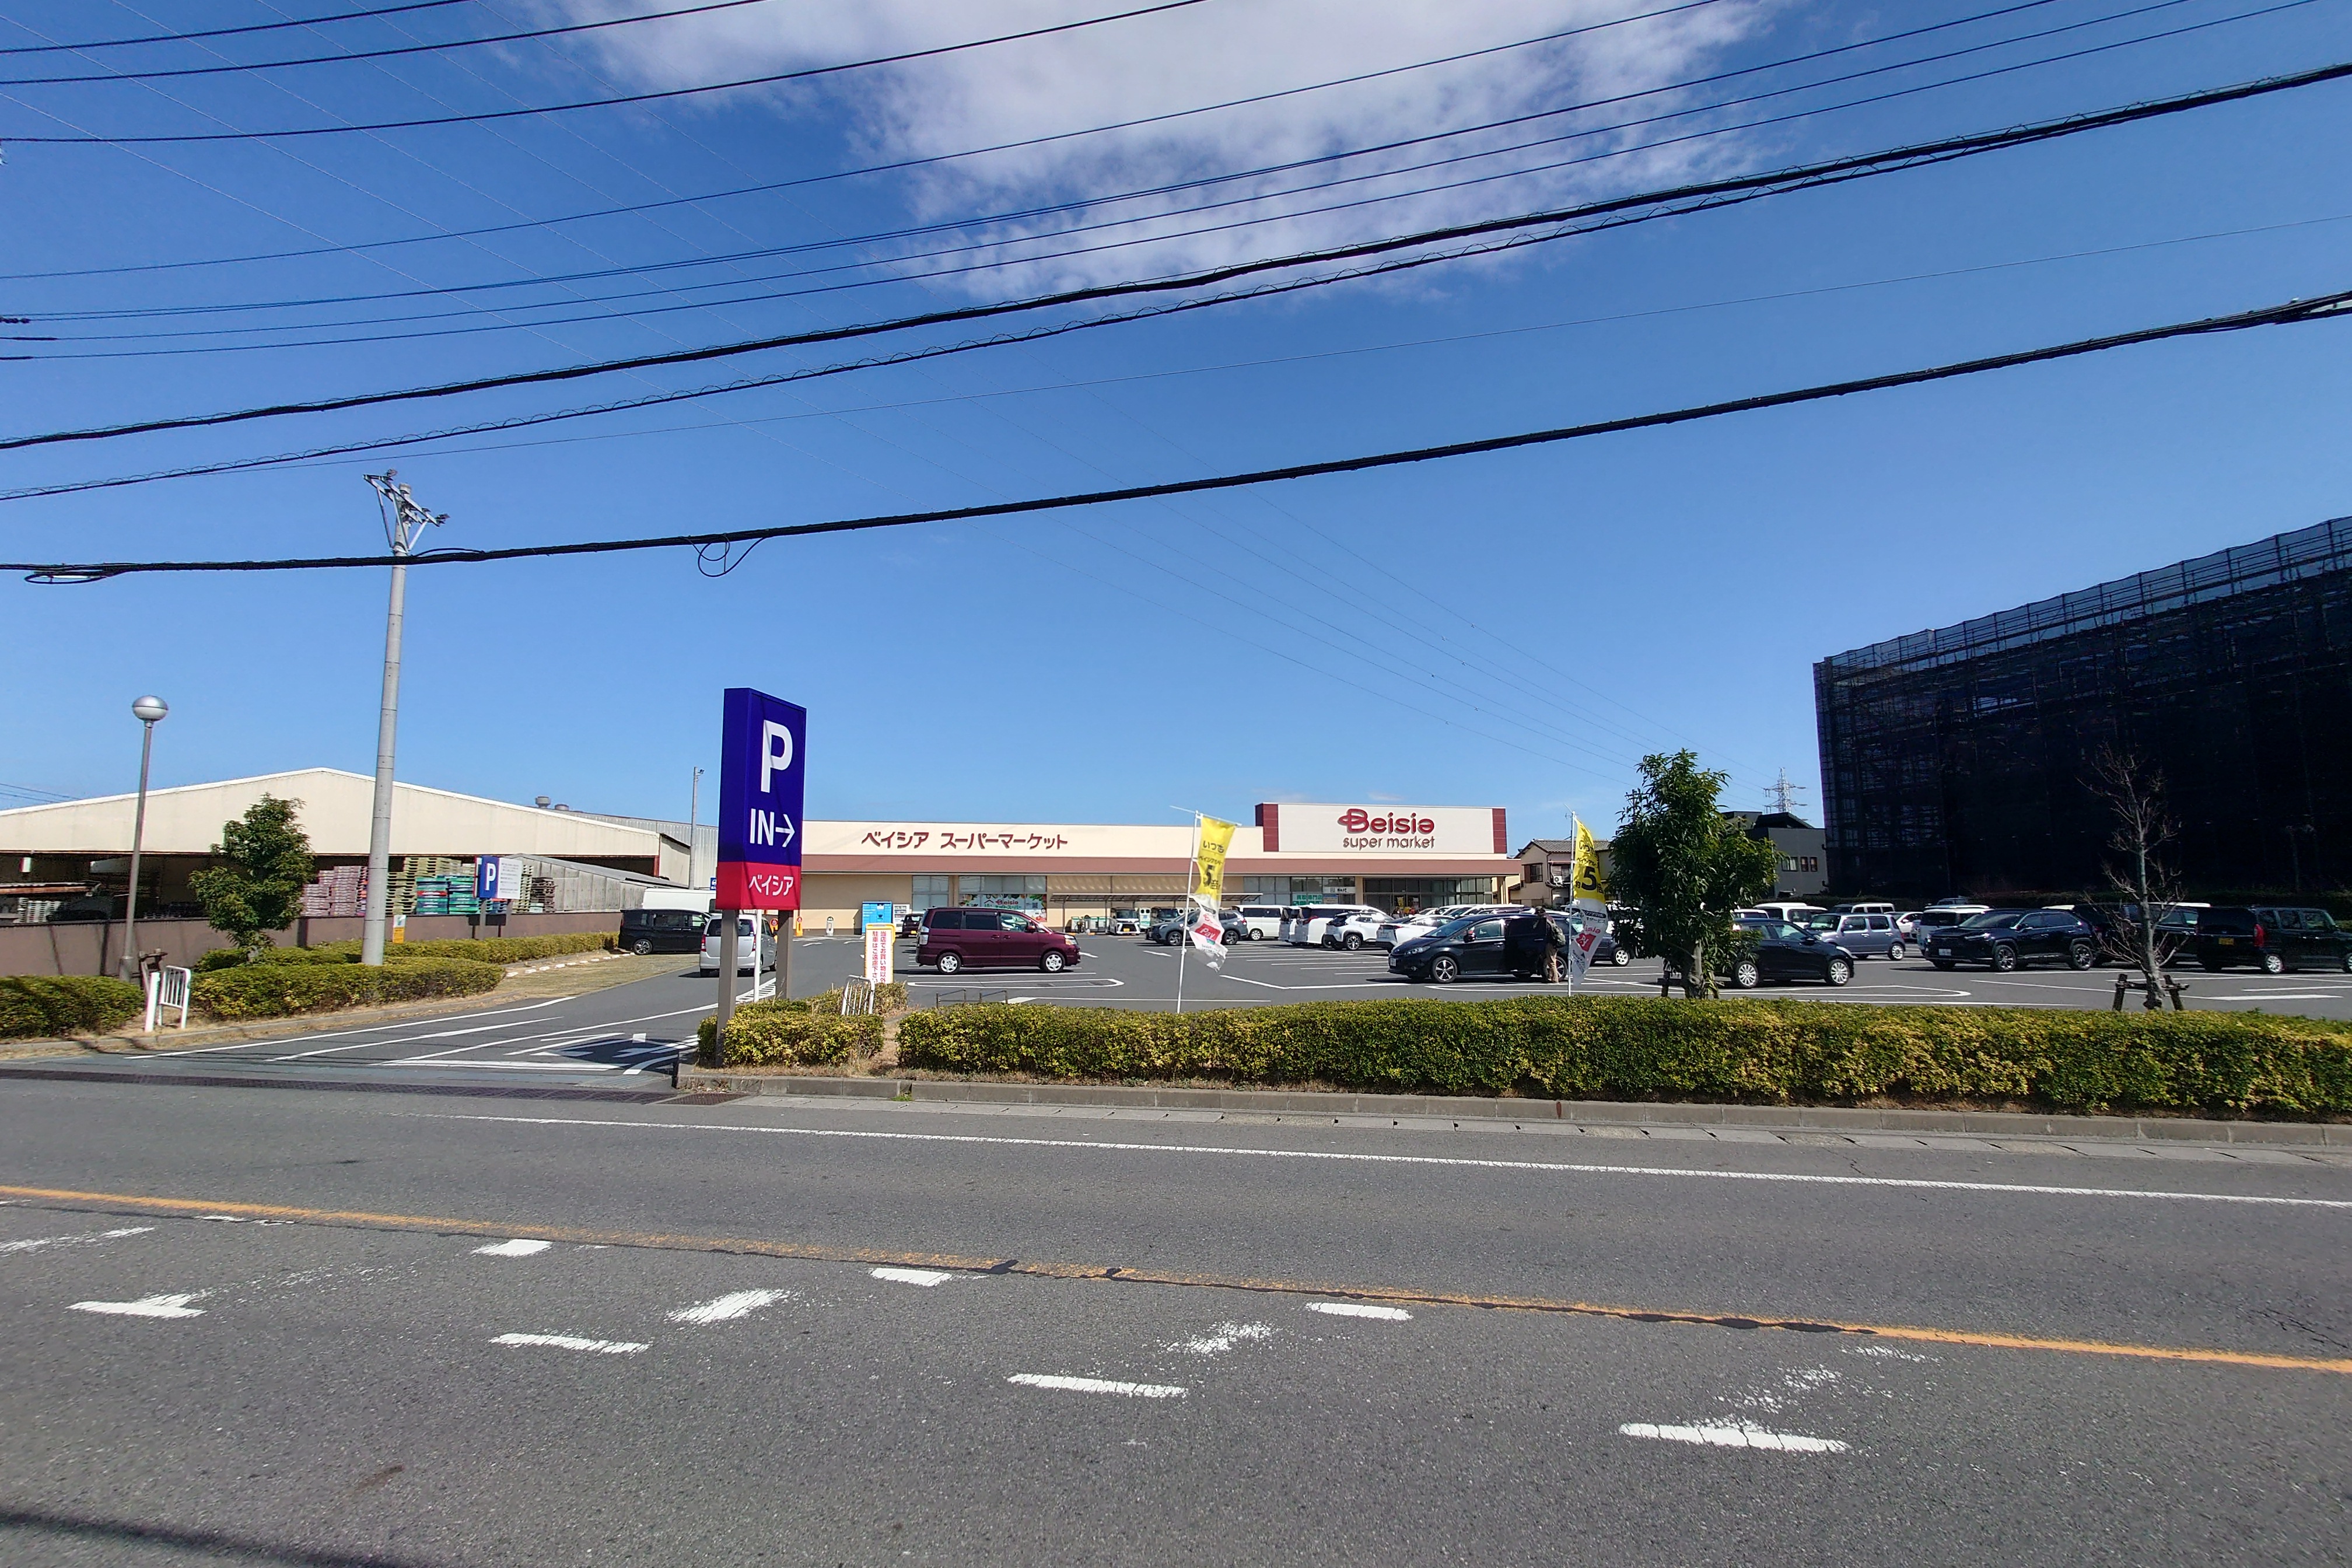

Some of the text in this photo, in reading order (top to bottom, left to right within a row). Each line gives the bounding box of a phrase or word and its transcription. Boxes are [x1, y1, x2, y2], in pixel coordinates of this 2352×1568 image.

[760, 719, 793, 793] P
[749, 808, 775, 846] IN
[1338, 808, 1435, 834] Beisia
[862, 831, 1068, 850] ベイシア スーパーマーケット
[1343, 835, 1435, 851] super market
[485, 863, 496, 891] P
[748, 875, 794, 897] ベイシア
[1200, 928, 1216, 940] Pay
